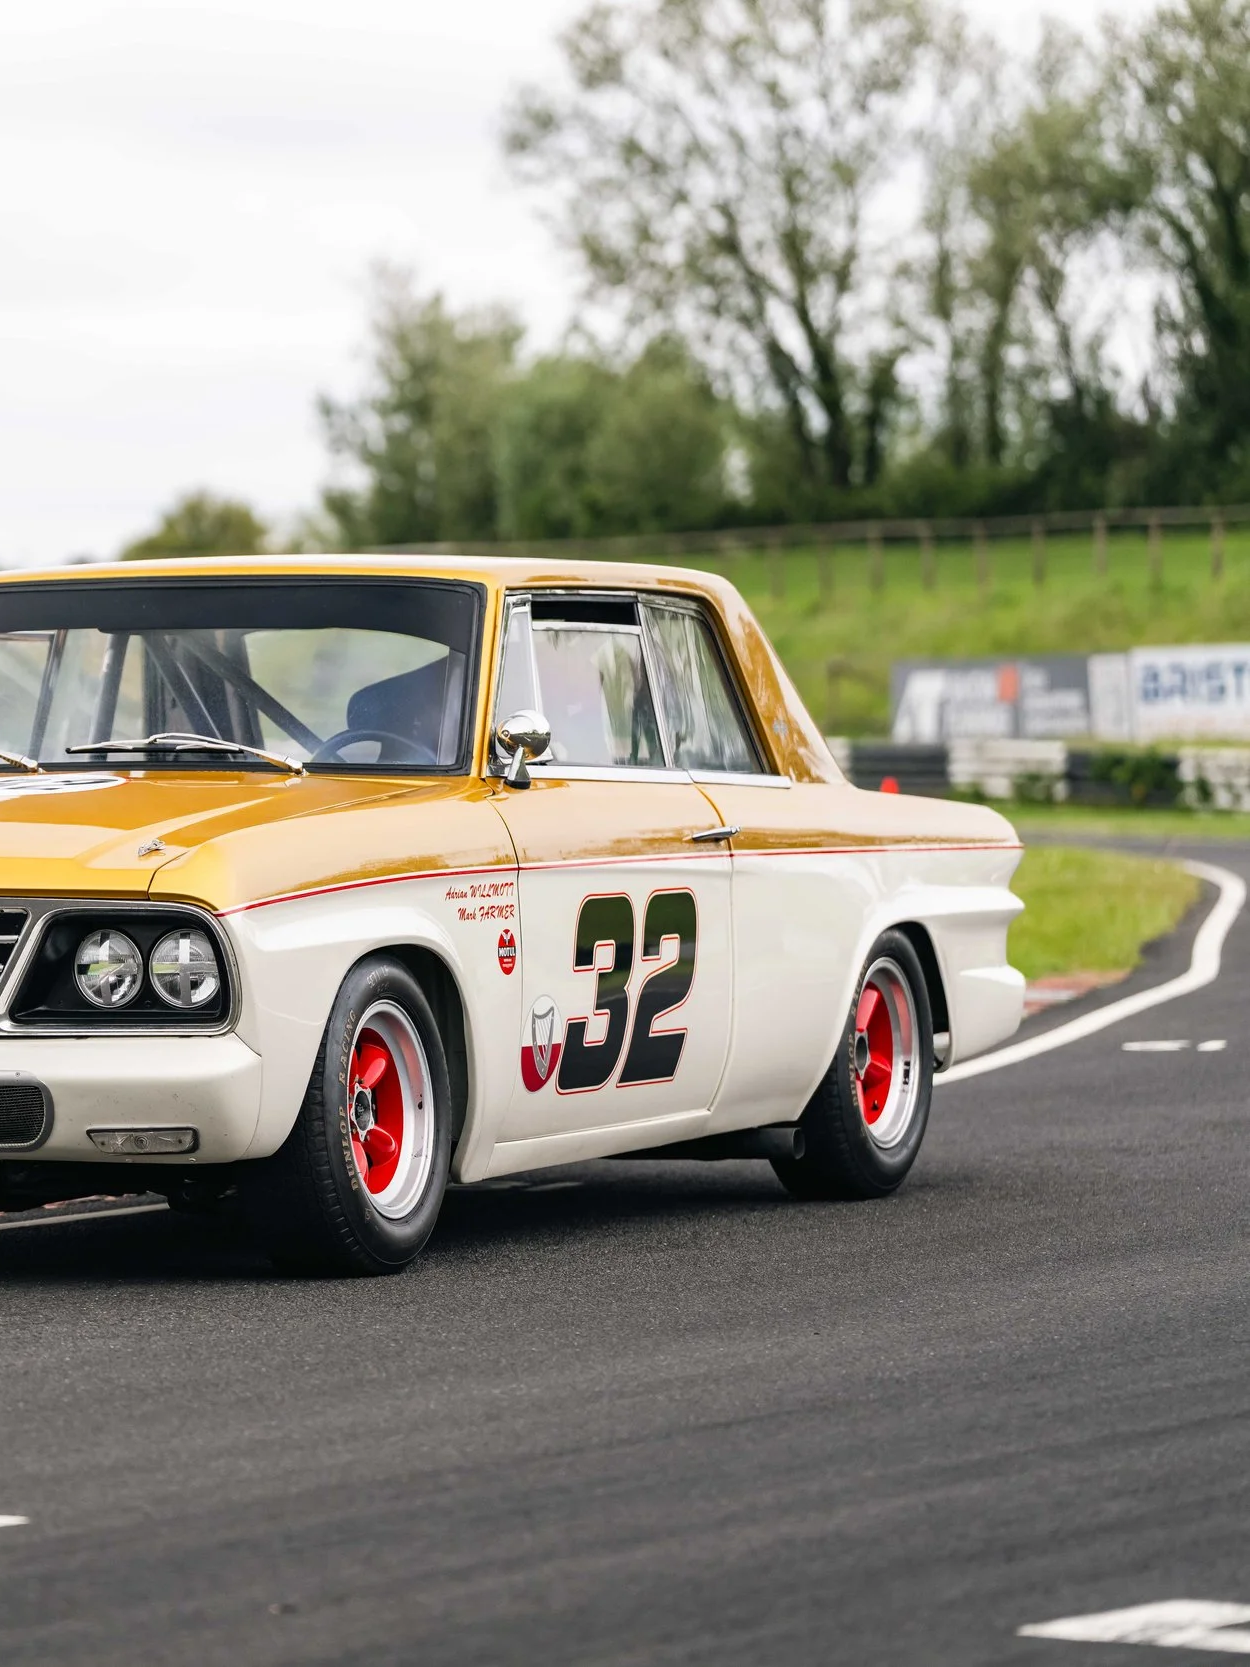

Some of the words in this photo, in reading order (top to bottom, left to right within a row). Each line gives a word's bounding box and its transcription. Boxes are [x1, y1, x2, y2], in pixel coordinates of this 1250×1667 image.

[445, 886, 468, 901] Adrian
[470, 882, 514, 898] WILLMOTT
[457, 907, 477, 921] Mark
[478, 904, 515, 922] FARMER
[498, 947, 516, 957] MOTUL
[555, 887, 699, 1095] 32
[338, 1008, 358, 1086] RACING
[339, 1105, 359, 1192] DUNLOP
